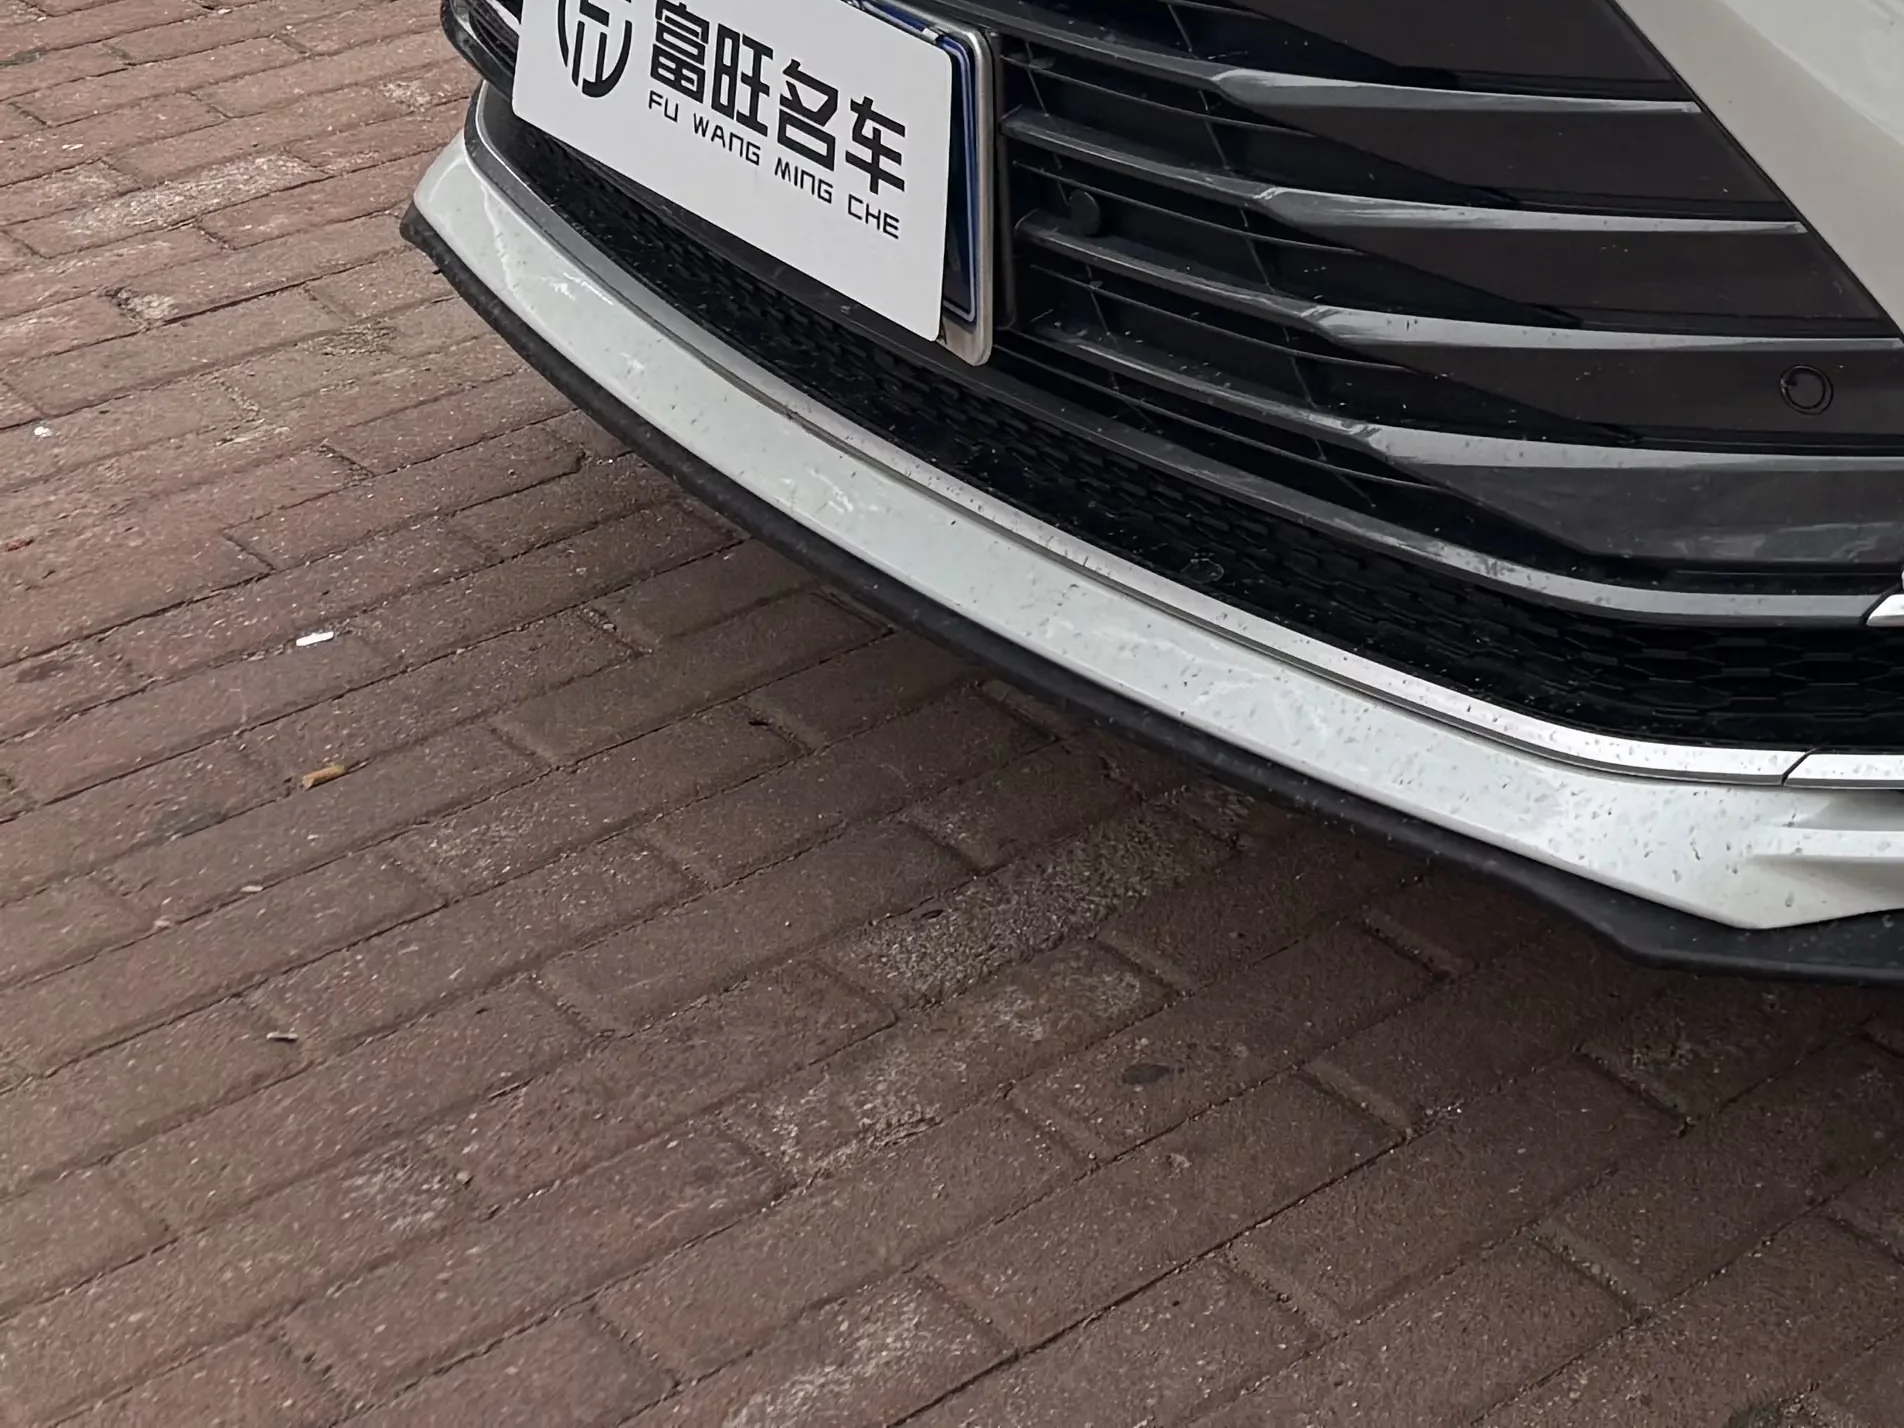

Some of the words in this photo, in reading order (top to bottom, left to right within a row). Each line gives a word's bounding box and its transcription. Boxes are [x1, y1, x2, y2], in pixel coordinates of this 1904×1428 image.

[648, 89, 679, 123] FU
[693, 112, 761, 166] WANG
[774, 156, 834, 204] MING
[847, 193, 900, 239] CHE
